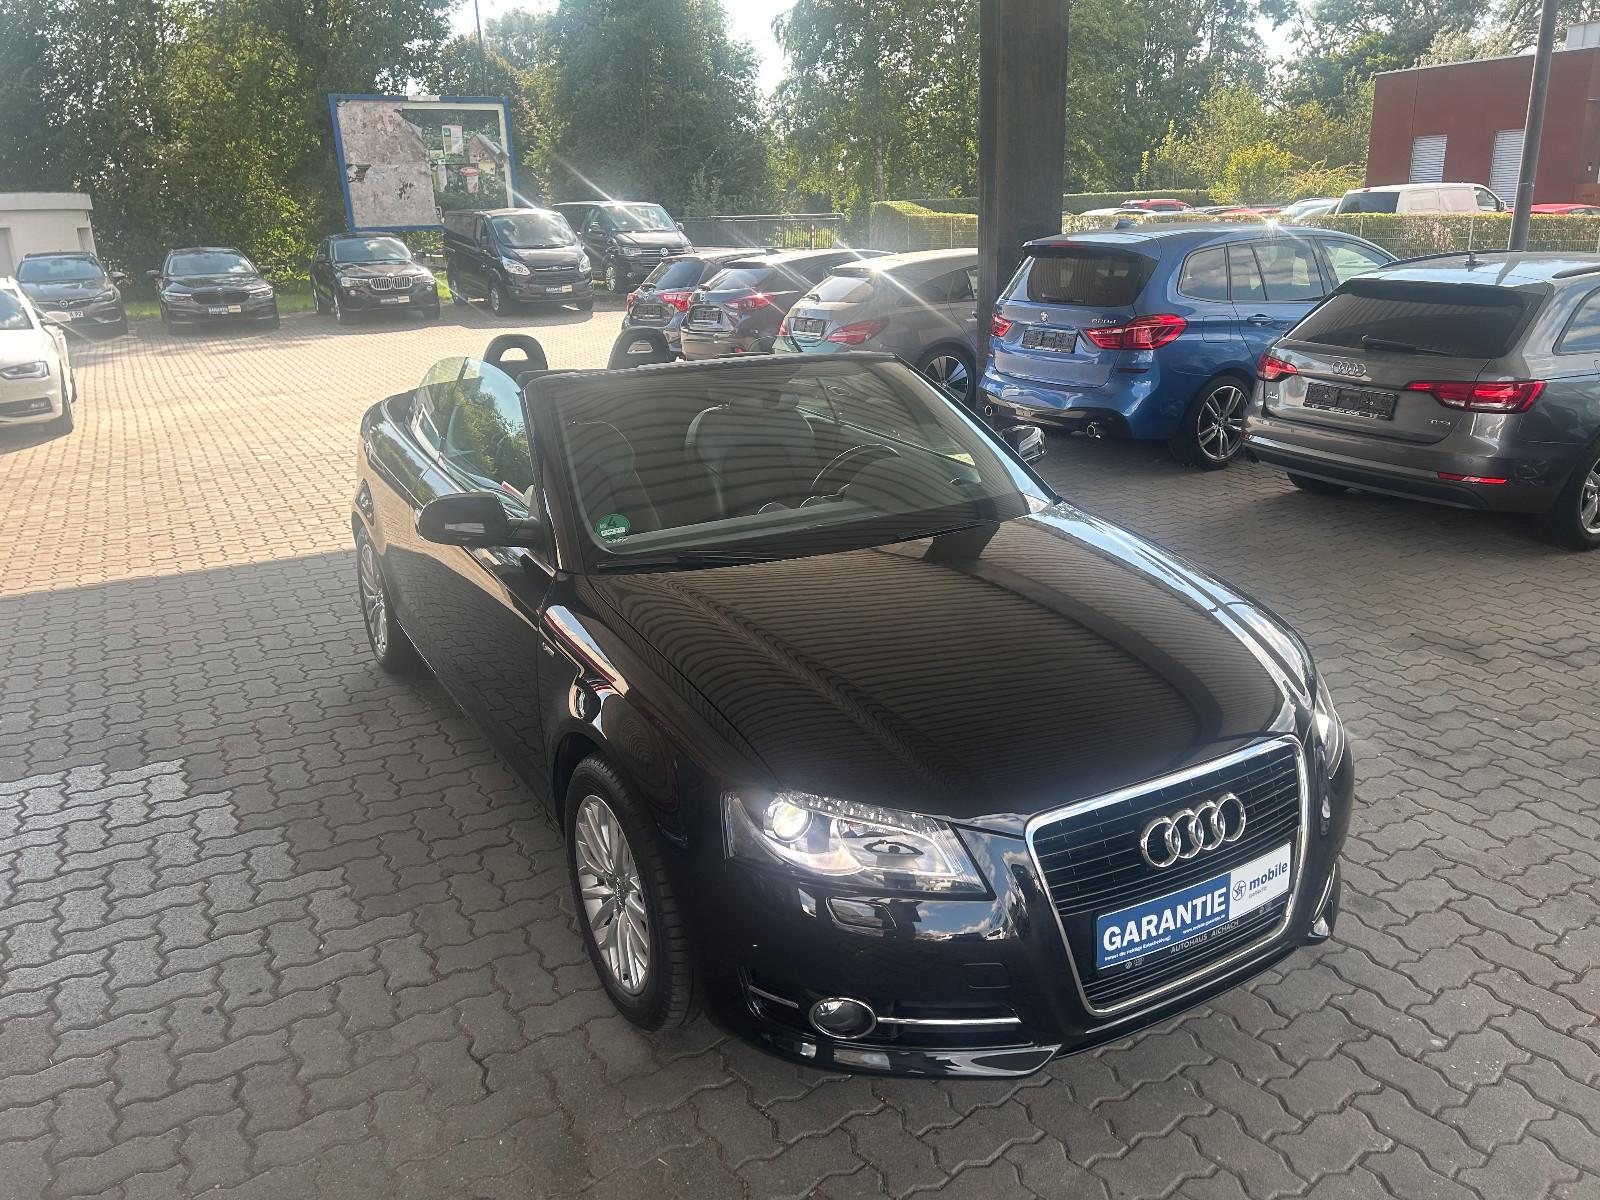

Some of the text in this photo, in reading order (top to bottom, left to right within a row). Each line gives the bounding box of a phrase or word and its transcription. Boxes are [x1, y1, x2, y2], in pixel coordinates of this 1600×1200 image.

[1249, 861, 1288, 890] mobile
[1103, 886, 1226, 952] GARANTIE
[1170, 920, 1239, 954] AUTOHAUS AICHACH
